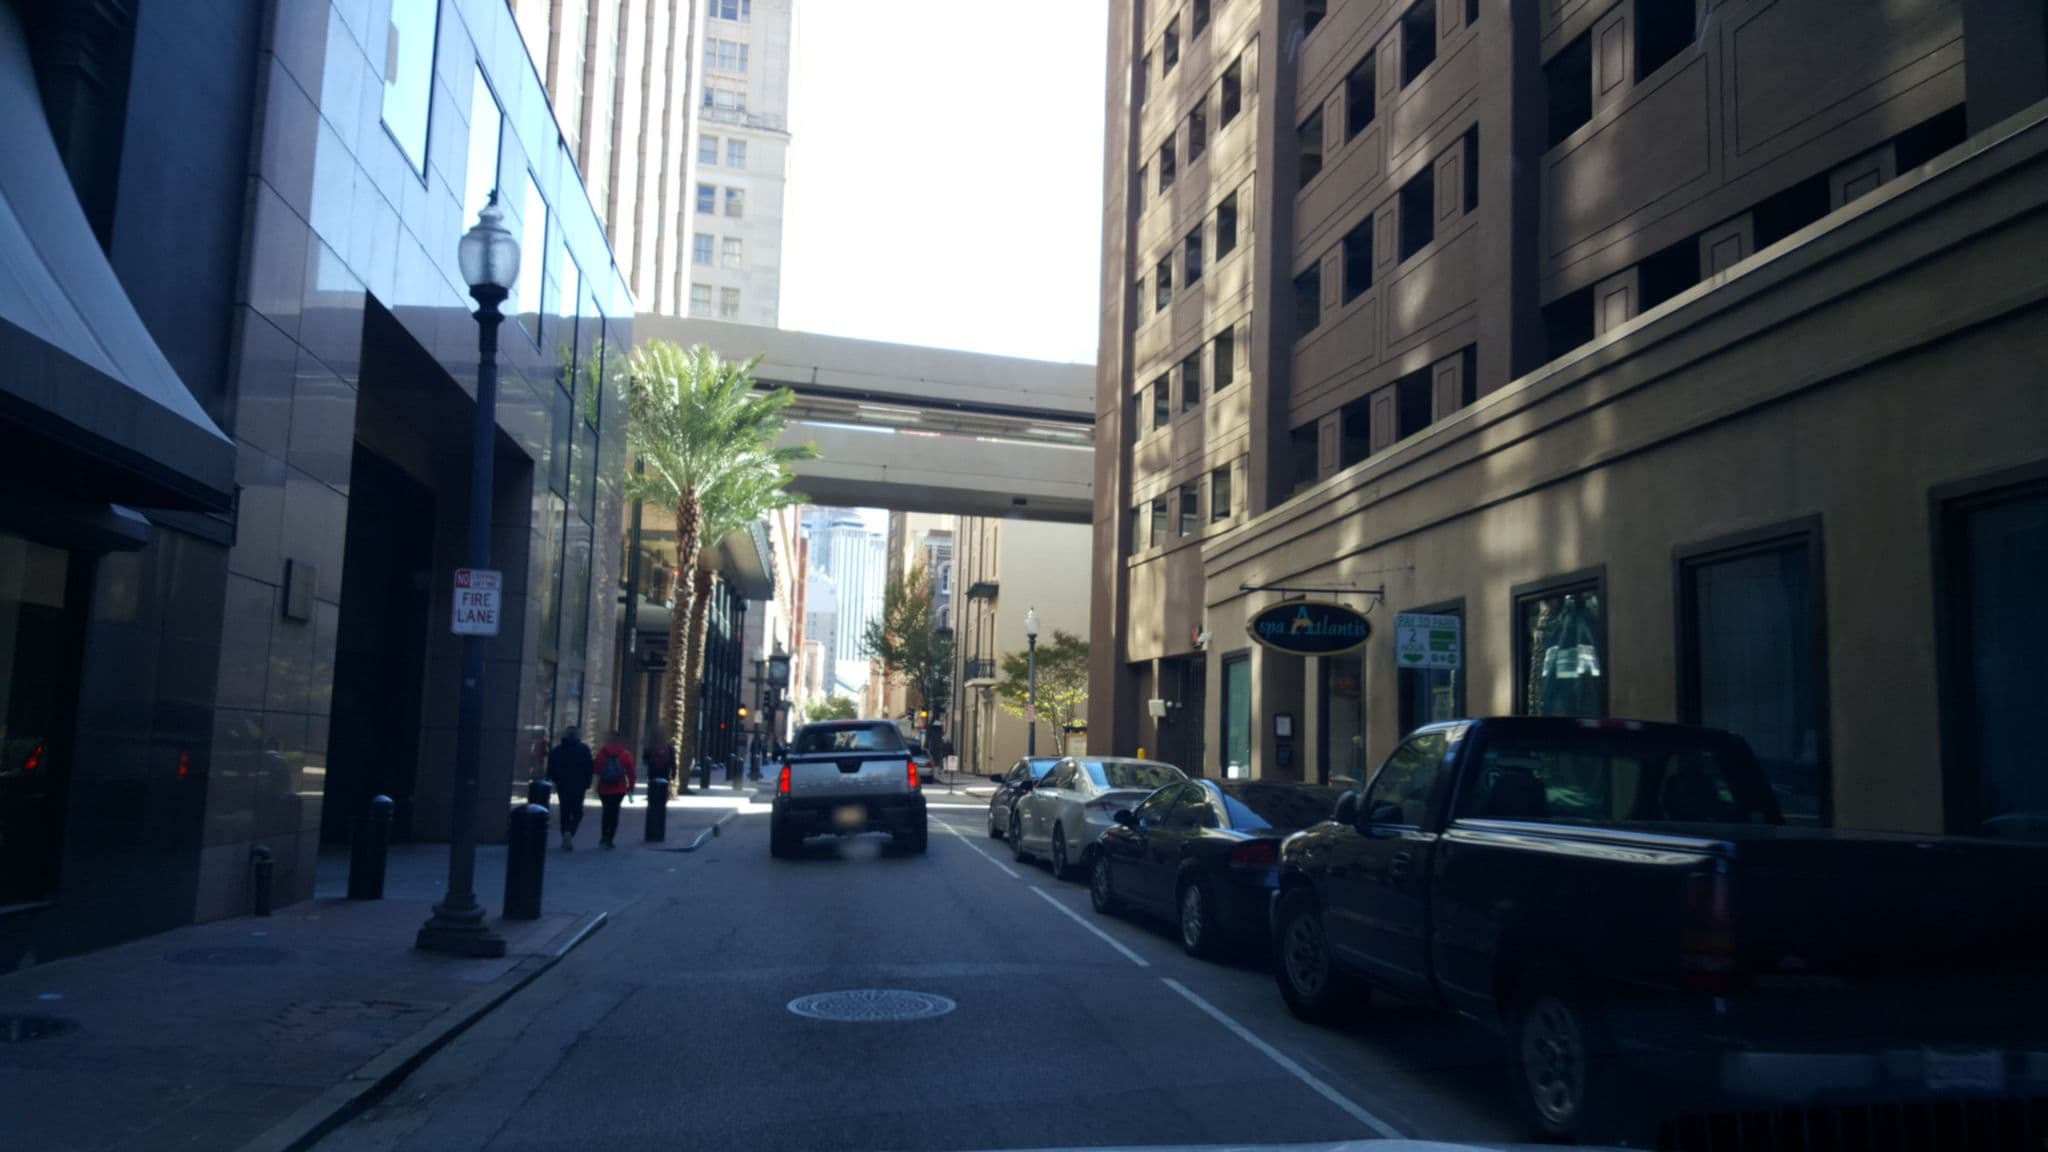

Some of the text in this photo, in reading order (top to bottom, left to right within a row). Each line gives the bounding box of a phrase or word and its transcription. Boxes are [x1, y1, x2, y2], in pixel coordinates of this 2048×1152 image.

[463, 592, 491, 607] FIRE
[457, 608, 494, 624] LANE
[1258, 606, 1367, 637] spa Atlantis
[1407, 628, 1416, 642] 2
